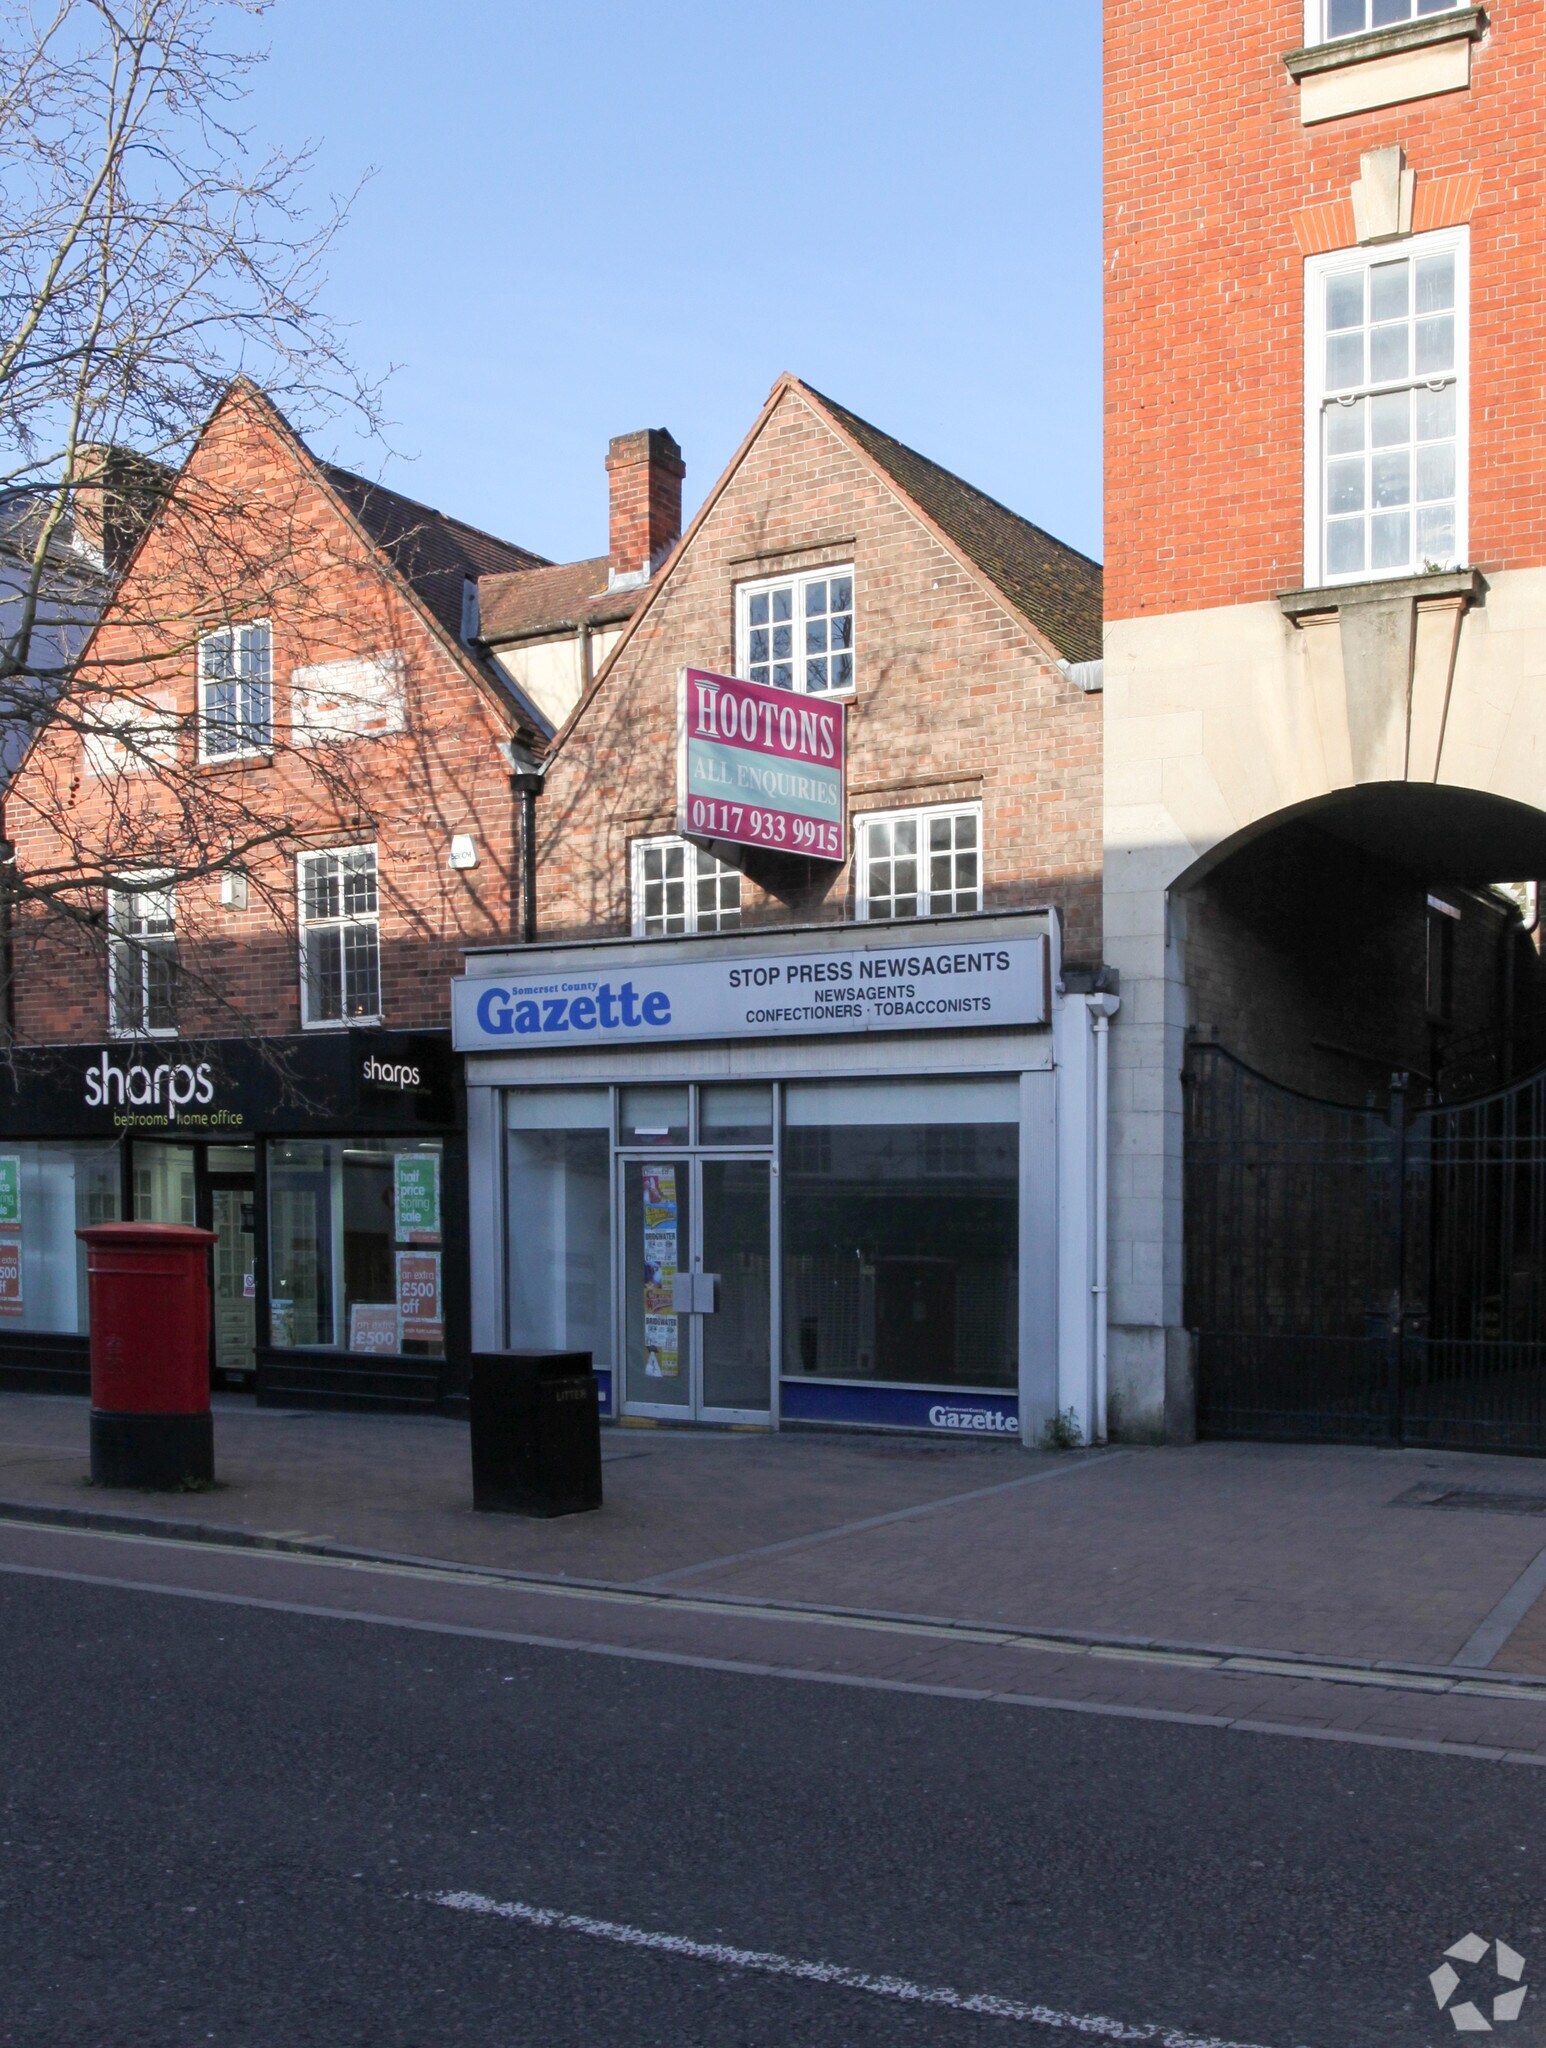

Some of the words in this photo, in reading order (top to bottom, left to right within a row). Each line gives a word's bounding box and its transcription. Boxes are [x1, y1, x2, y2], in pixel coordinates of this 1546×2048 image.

[694, 679, 834, 759] HOOTONS
[694, 758, 732, 784] ALL
[737, 765, 837, 806] ENQUIRIES
[692, 800, 743, 834] 0117
[750, 811, 786, 842] 933
[792, 819, 838, 851] 9915
[729, 968, 780, 987] STOP
[787, 962, 853, 984] PRESS
[859, 951, 1010, 979] NEWSAGENTS
[512, 984, 559, 996] Somerset
[561, 982, 598, 994] County
[814, 985, 915, 1002] NEWSAGENTS
[476, 981, 672, 1035] Gazette
[746, 1004, 862, 1023] CONFECTIONERS
[874, 997, 991, 1016] TOBACCONISTS
[363, 1055, 420, 1090] sharps
[84, 1051, 214, 1119] sharps
[114, 1112, 169, 1126] bedrooms
[177, 1110, 208, 1126] home
[210, 1110, 244, 1125] office
[400, 1169, 420, 1182] half
[400, 1183, 425, 1199] price
[401, 1196, 430, 1211] spring
[401, 1210, 421, 1222] sale
[0, 1266, 17, 1279] 500
[402, 1271, 412, 1280] an
[414, 1270, 434, 1280] extra
[401, 1282, 434, 1298] £500
[402, 1299, 420, 1314] off
[356, 1331, 395, 1346] £500
[928, 1405, 1019, 1432] Gazette
